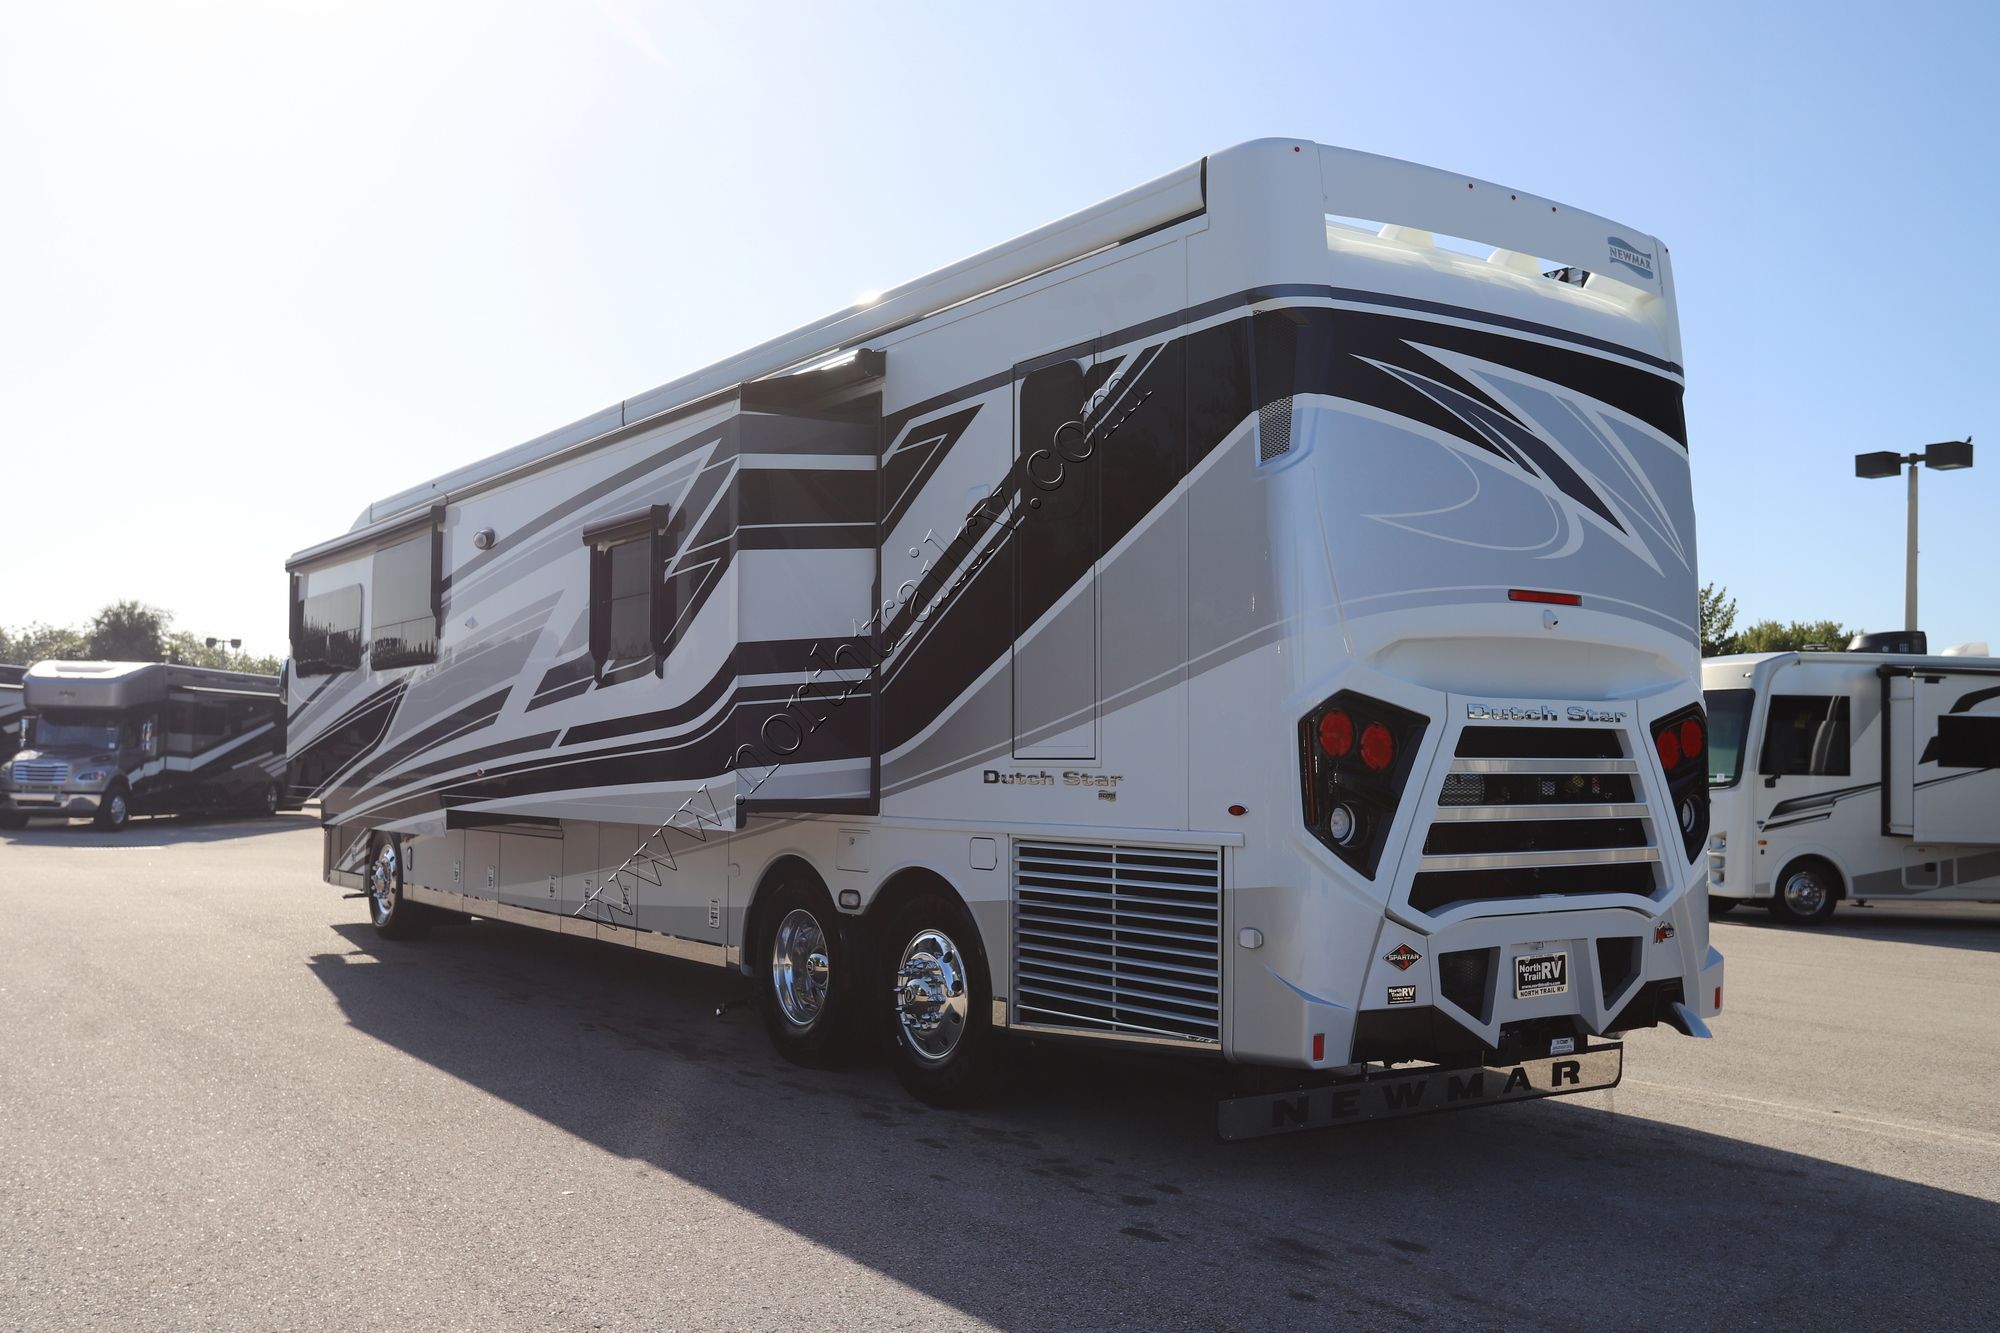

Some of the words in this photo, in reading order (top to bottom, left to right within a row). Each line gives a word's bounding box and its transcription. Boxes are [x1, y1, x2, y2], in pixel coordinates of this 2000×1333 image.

[1609, 246, 1651, 270] NEWMAR
[1467, 703, 1558, 721] Dutch
[1566, 706, 1627, 723] Star
[983, 770, 1055, 785] Dutch
[1062, 771, 1124, 787] Star
[1520, 963, 1541, 973] North
[1541, 961, 1562, 980] RV
[1524, 972, 1541, 981] Trail
[1402, 987, 1414, 997] RV
[1272, 1060, 1580, 1127] NEWMAR
